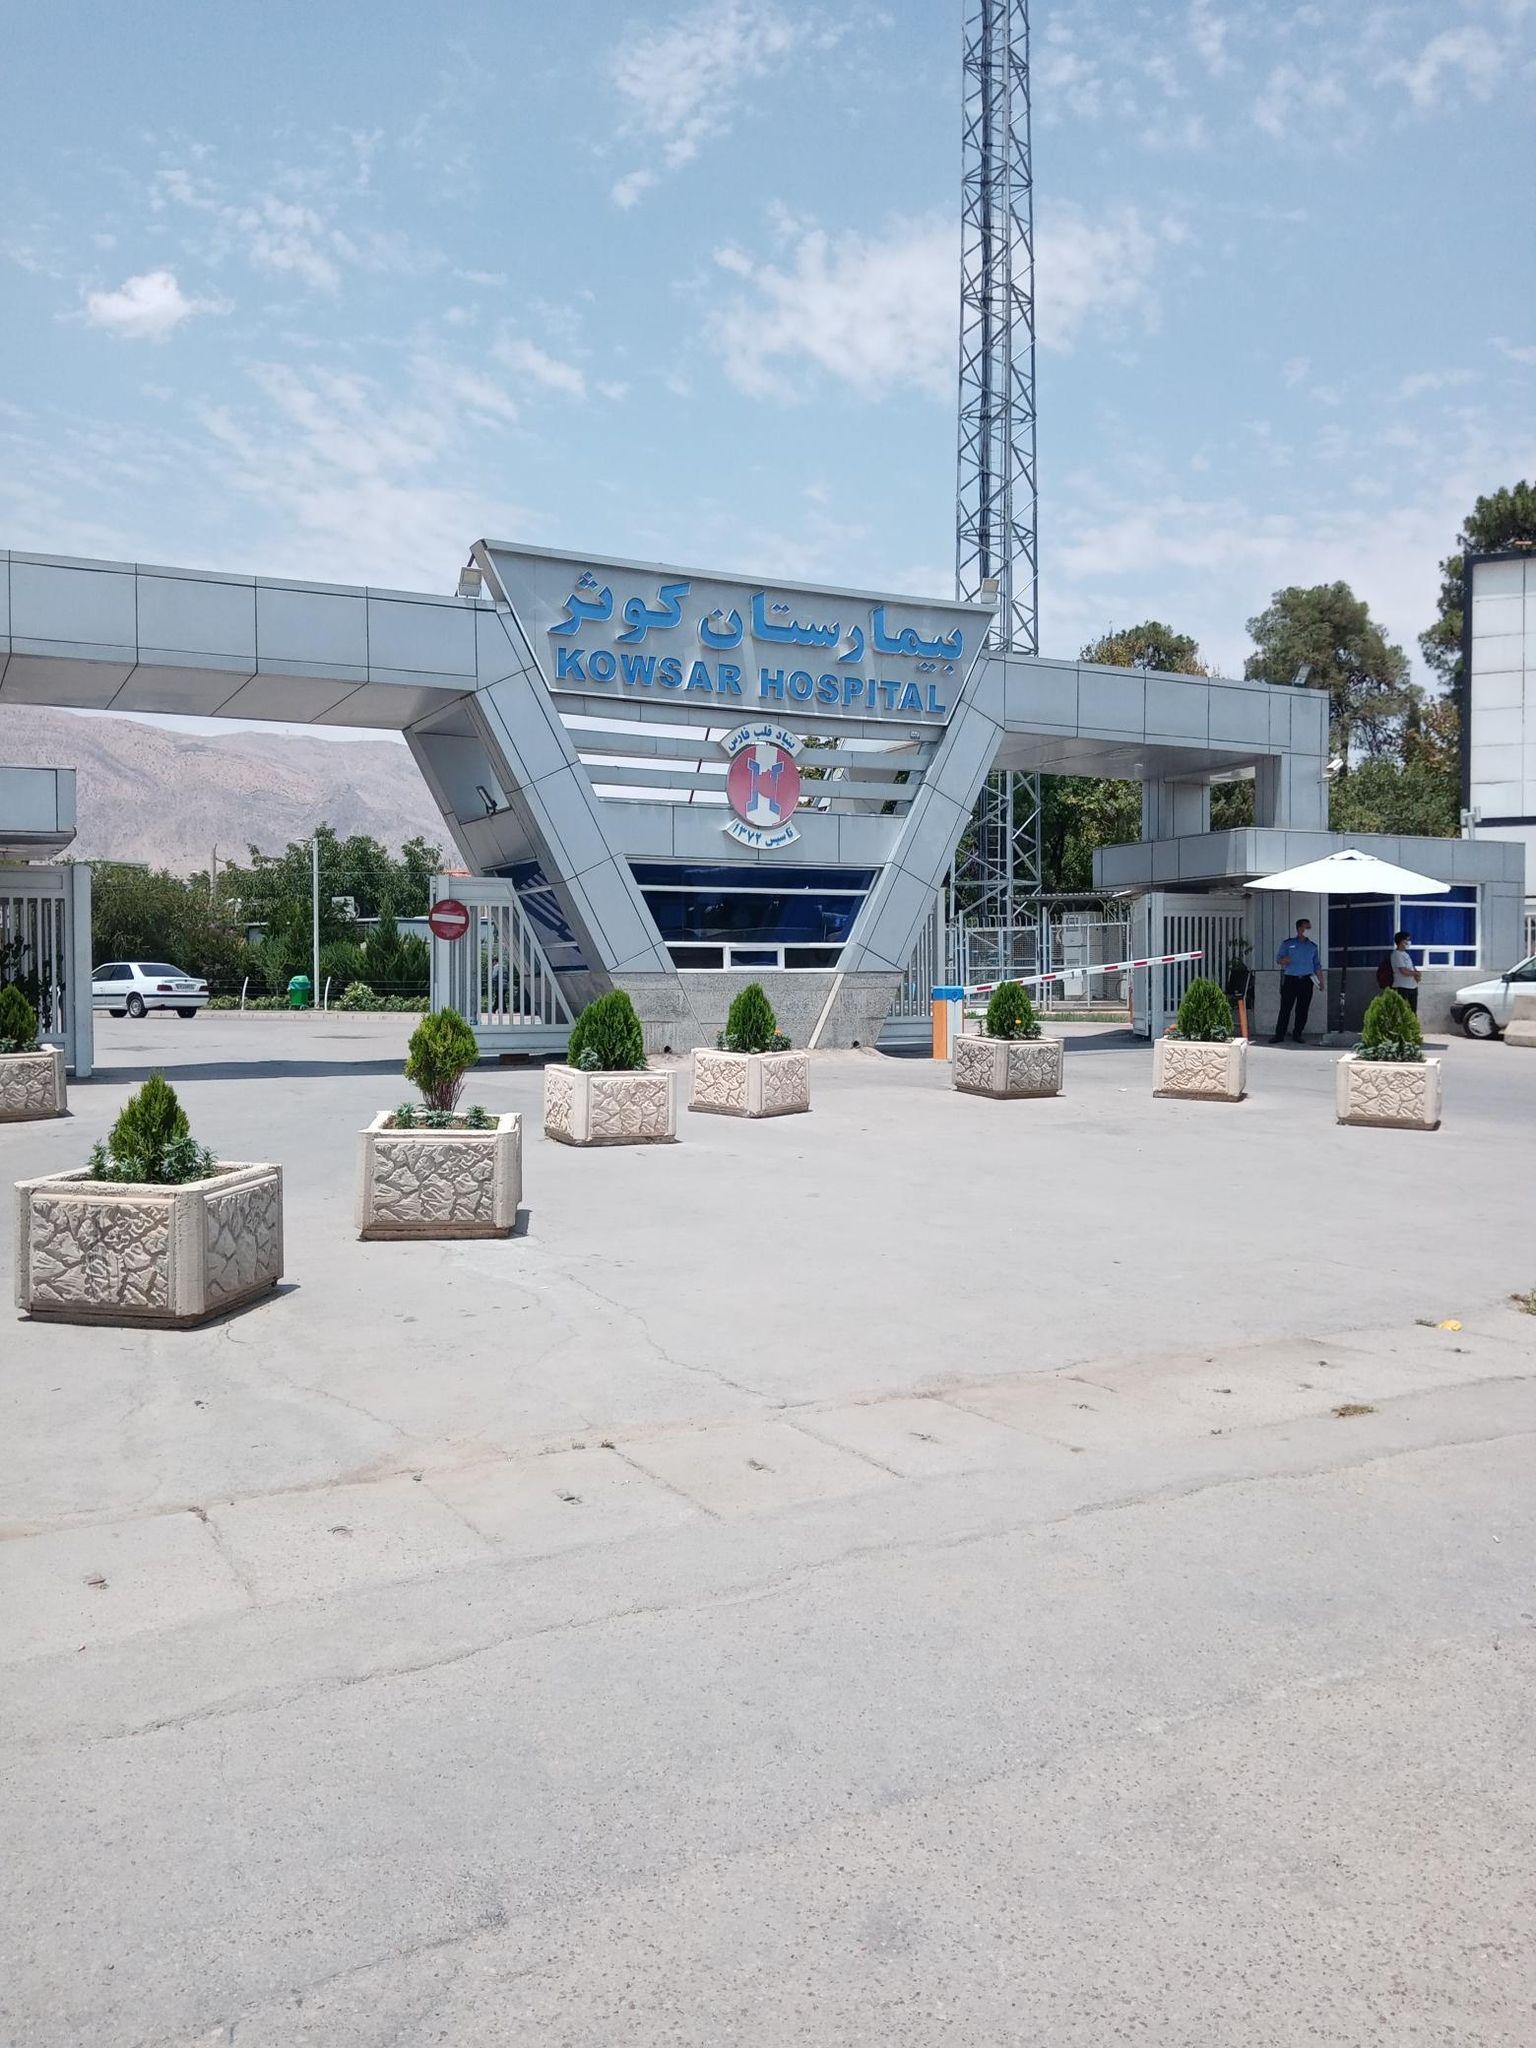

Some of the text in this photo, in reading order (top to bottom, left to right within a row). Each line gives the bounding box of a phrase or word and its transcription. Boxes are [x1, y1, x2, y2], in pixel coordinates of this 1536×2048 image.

[547, 569, 964, 675] بیمارستان کوثر
[556, 647, 947, 714] KOWSAR HOSPITAL
[728, 725, 796, 751] بنیاد قلب فارس
